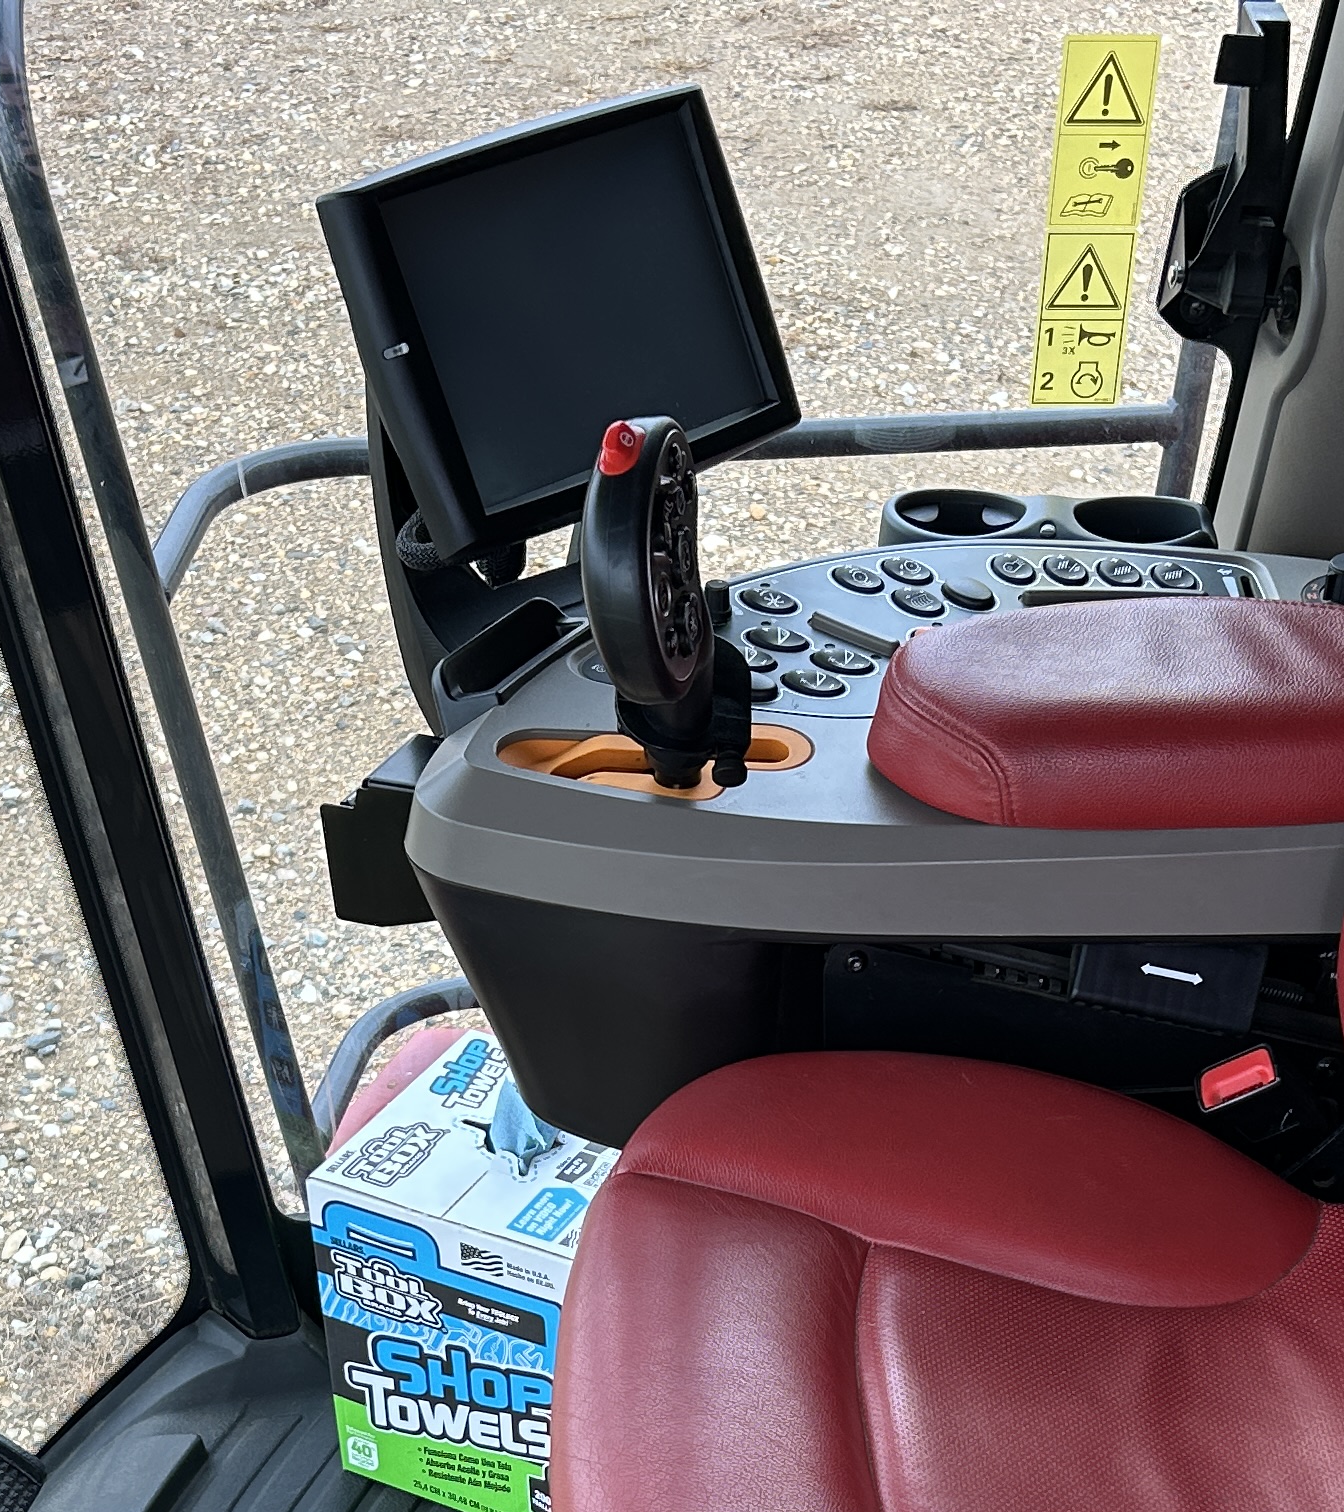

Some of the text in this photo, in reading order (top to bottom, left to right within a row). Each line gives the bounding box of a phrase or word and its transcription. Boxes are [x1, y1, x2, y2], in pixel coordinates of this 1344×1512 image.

[1045, 327, 1054, 346] 1
[1062, 346, 1076, 355] 3X
[1040, 372, 1054, 390] 2
[430, 1039, 489, 1095] SHOP
[347, 1130, 408, 1175] TOOL
[368, 1125, 438, 1184] BOX
[335, 1254, 420, 1295] TOOL
[339, 1272, 438, 1324] BOX
[377, 1340, 552, 1413] SHOP
[352, 1370, 551, 1457] TOWELS
[351, 1441, 372, 1458] 40
